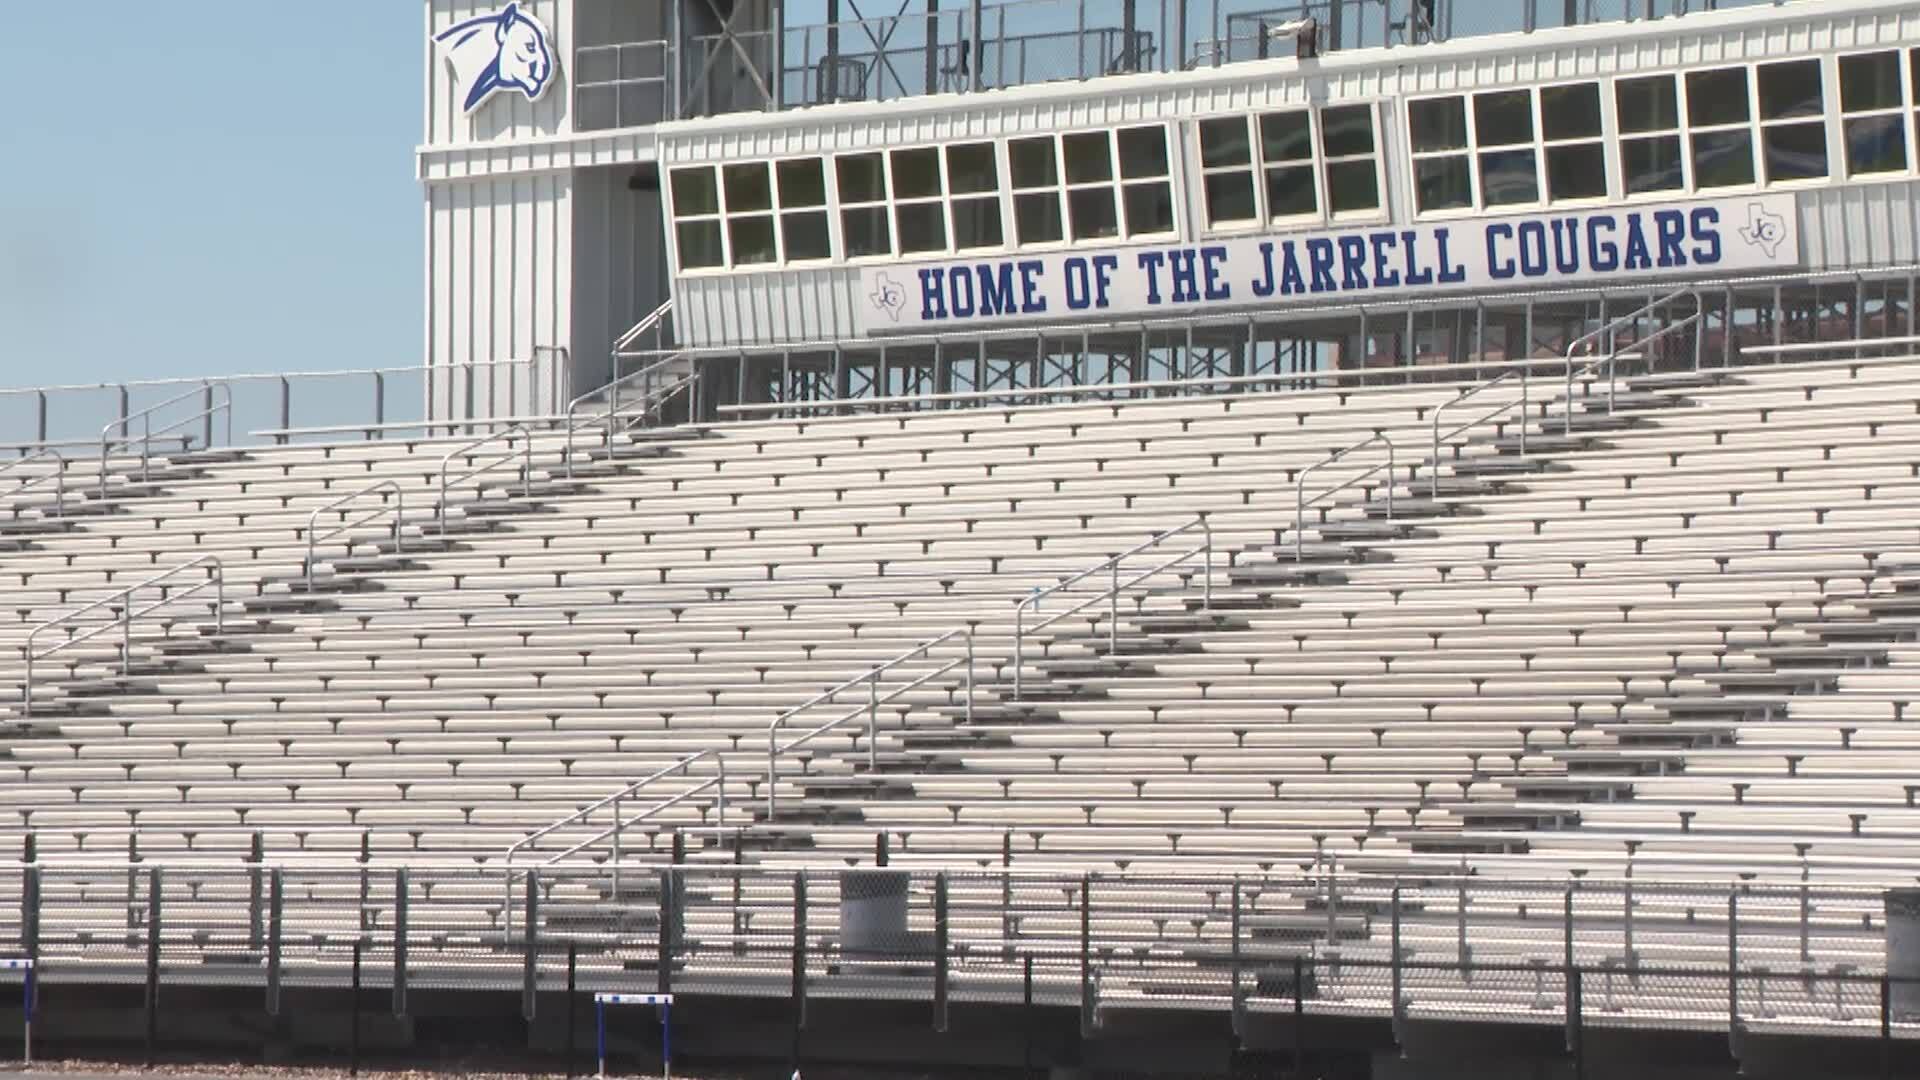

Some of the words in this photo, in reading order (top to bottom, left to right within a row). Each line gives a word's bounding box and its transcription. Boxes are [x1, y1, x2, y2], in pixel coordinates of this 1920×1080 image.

[919, 261, 1046, 320] HOME
[1065, 256, 1116, 309] OF
[1138, 247, 1231, 304] THE
[1254, 228, 1466, 296] JARRELL
[1486, 207, 1723, 278] COUGARS
